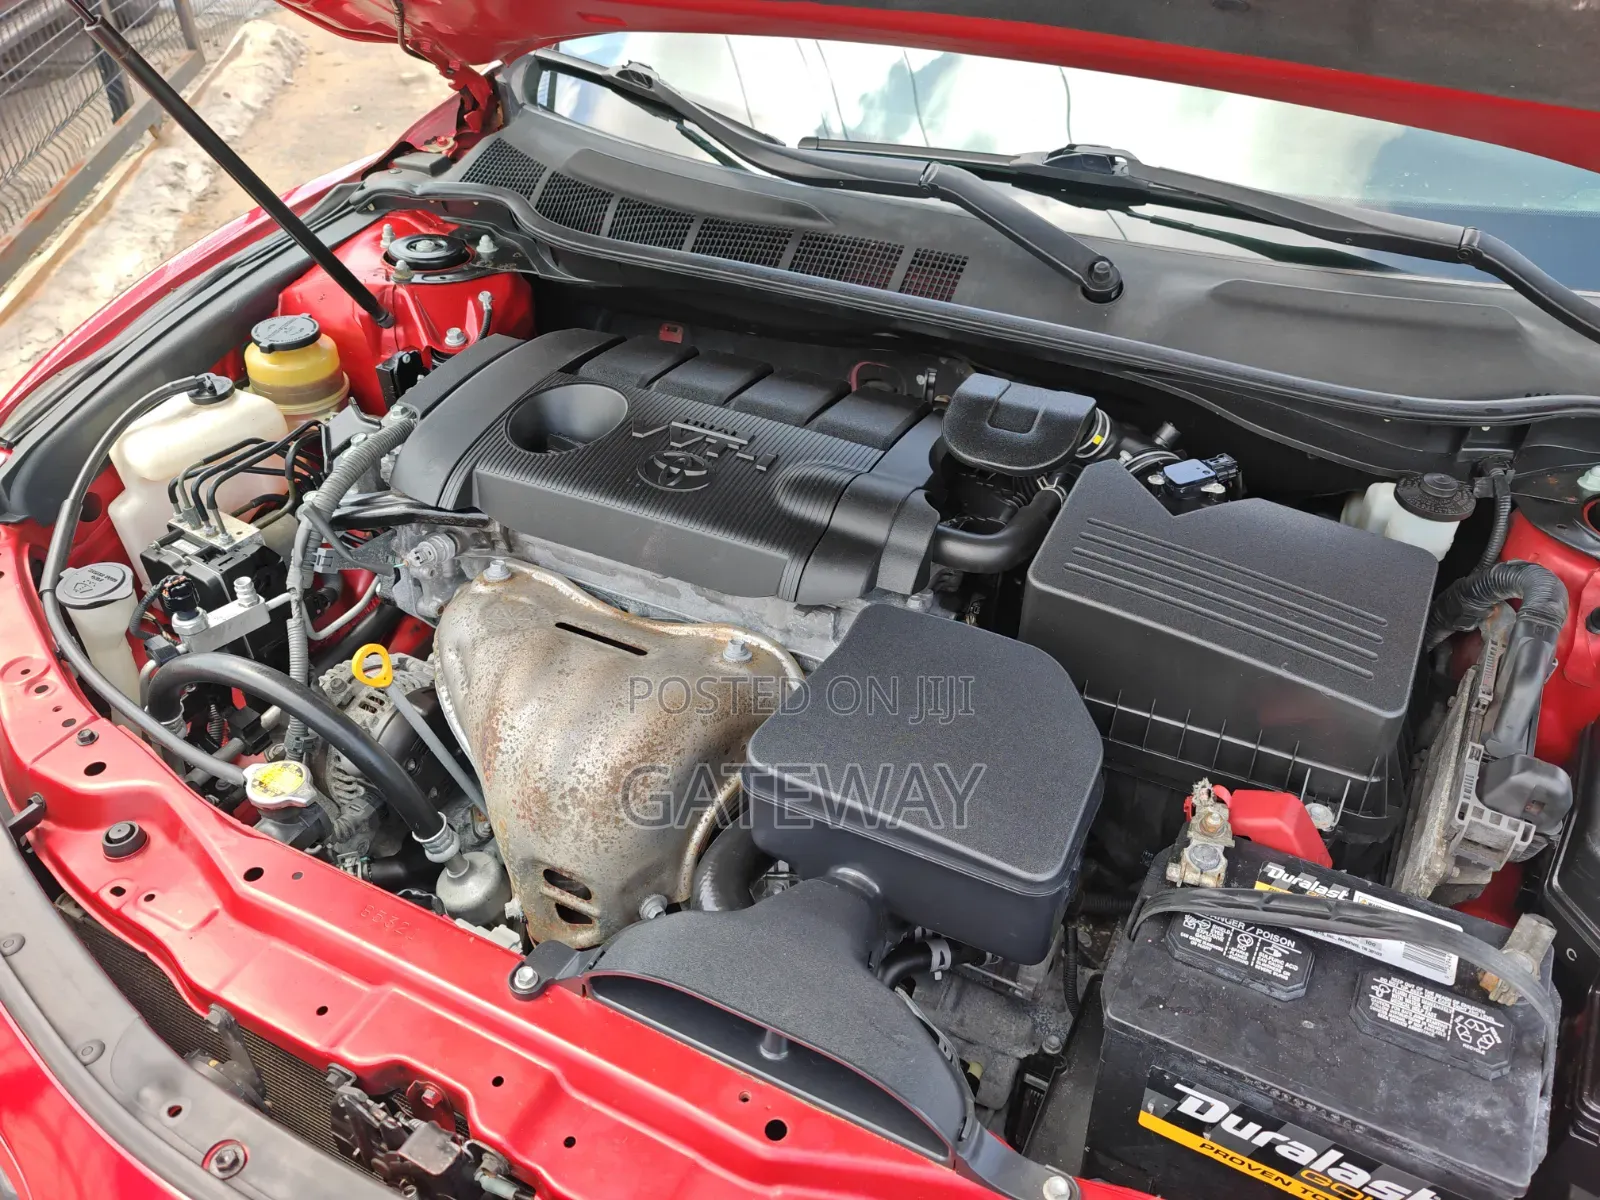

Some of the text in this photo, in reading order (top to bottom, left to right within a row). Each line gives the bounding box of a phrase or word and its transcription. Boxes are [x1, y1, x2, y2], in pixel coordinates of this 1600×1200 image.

[1267, 864, 1349, 900] Duralast
[1209, 914, 1245, 930] ANGER
[1256, 929, 1295, 948] POISON
[1463, 1044, 1485, 1054] RECYCLE
[1200, 1143, 1293, 1188] PROVEN
[1301, 1169, 1373, 1200] GO
